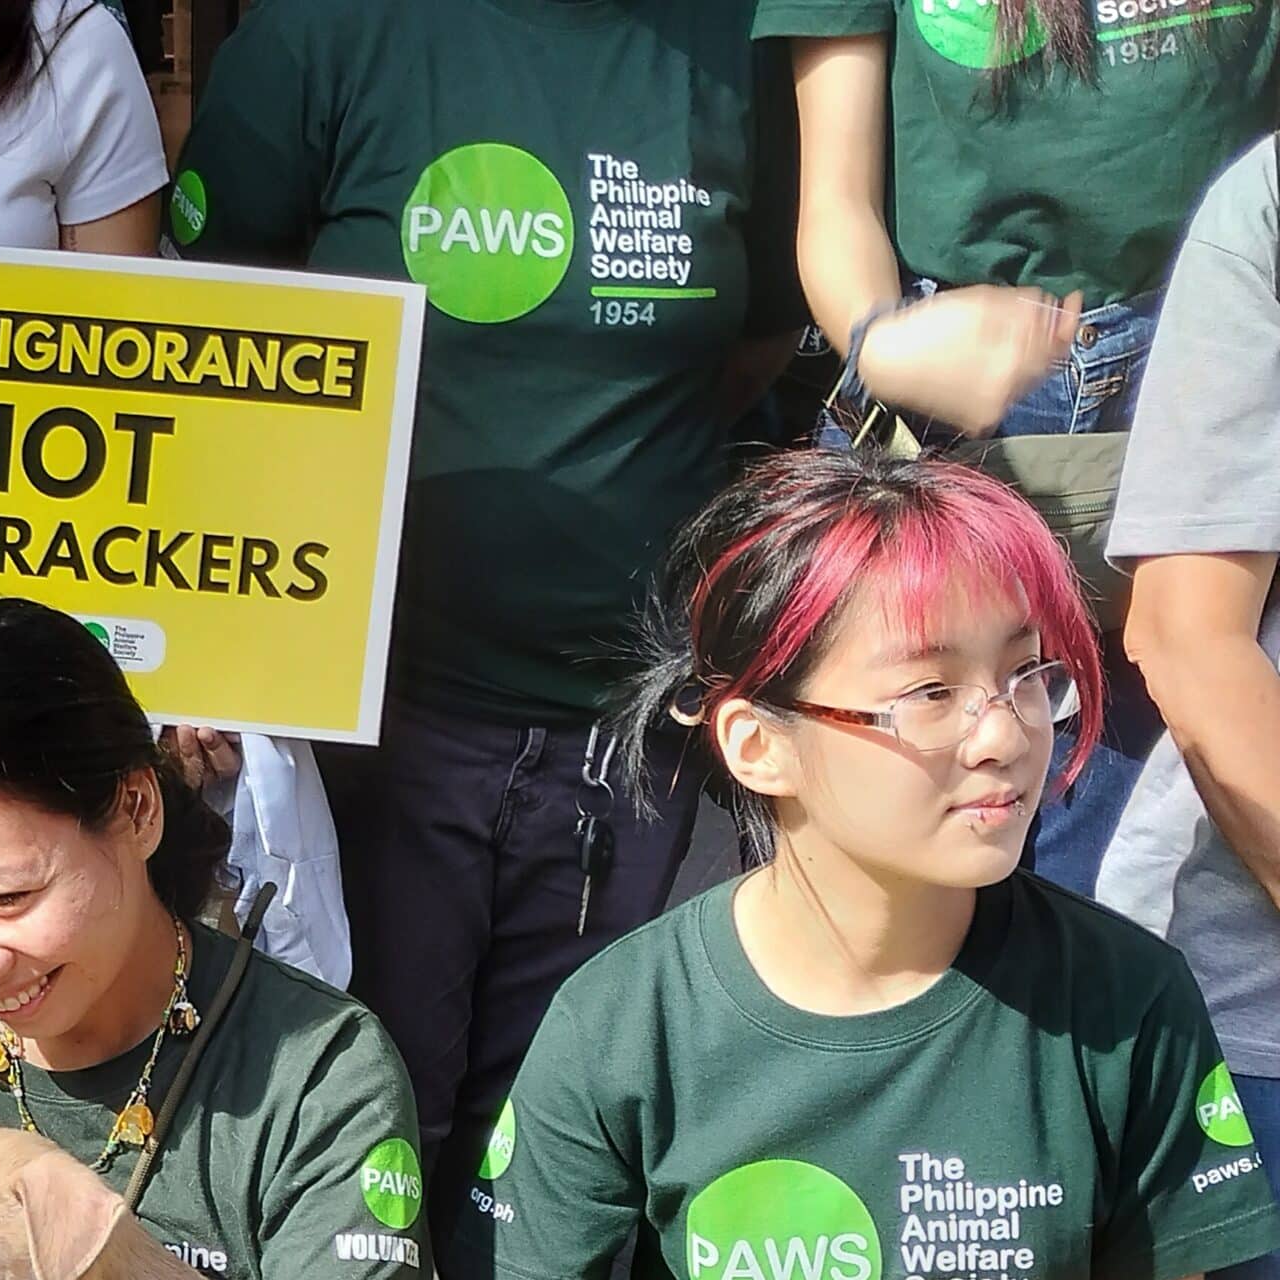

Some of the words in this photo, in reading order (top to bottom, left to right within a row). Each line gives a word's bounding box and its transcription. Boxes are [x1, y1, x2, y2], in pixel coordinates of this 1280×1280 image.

[588, 154, 638, 180] The
[409, 205, 566, 258] PAWS
[590, 204, 681, 229] Animal
[590, 229, 693, 254] Welfare
[590, 254, 691, 286] Society
[589, 302, 656, 327] 1954
[1199, 1091, 1244, 1128] PA
[898, 1152, 964, 1182] The
[1192, 1152, 1263, 1193] paws.
[362, 1168, 419, 1199] PAWS
[900, 1179, 1063, 1217] Philippine
[901, 1211, 1019, 1243] Animal
[900, 1244, 1034, 1274] Welfare
